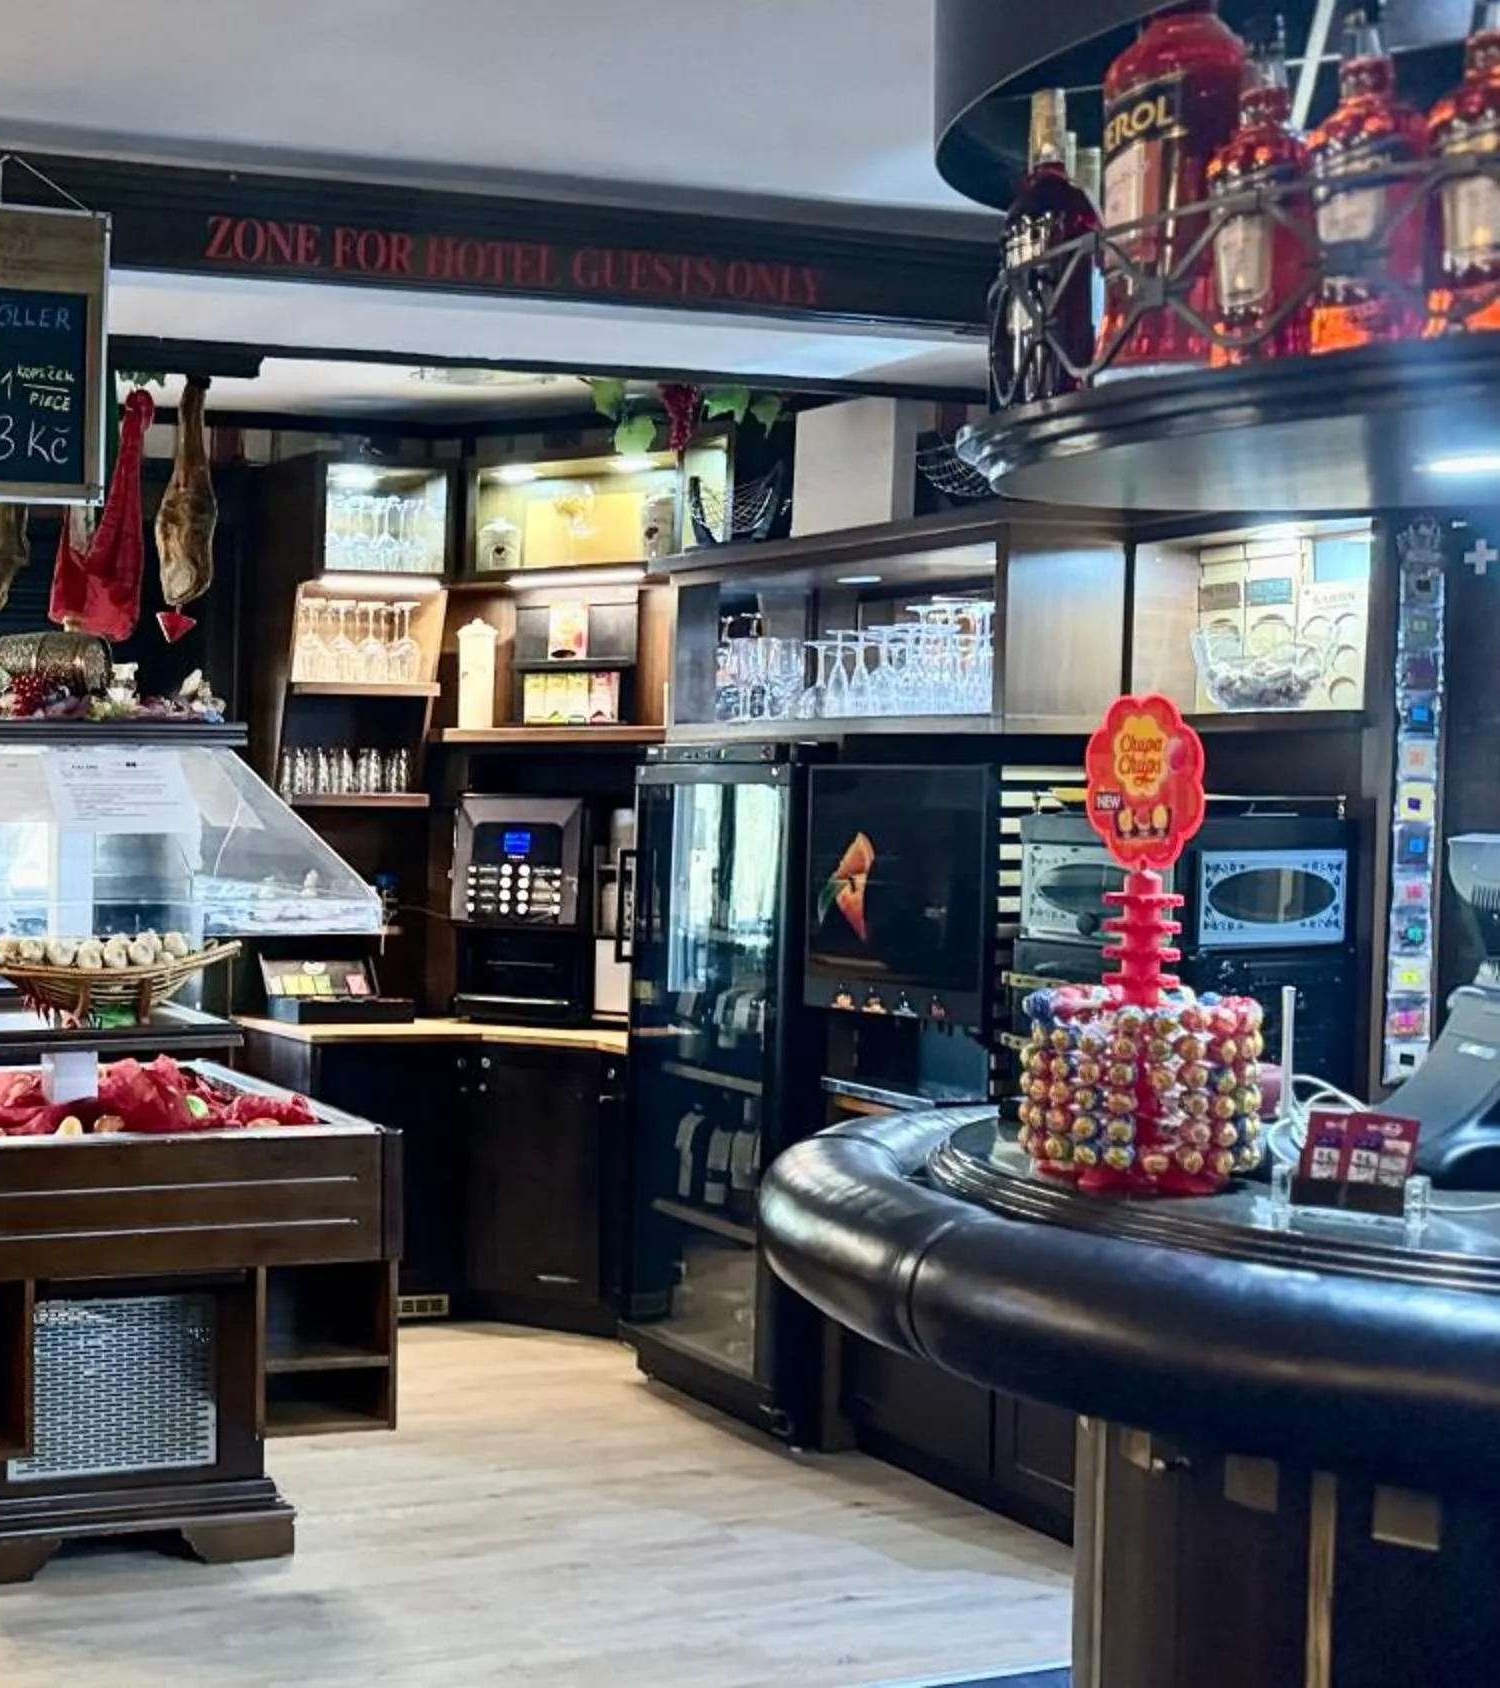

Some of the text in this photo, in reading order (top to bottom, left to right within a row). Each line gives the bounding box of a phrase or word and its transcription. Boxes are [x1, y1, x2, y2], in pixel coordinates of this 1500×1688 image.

[1104, 95, 1173, 153] EROL
[205, 215, 825, 305] ZONE FOR HOTEL GUESTS ONLY
[0, 369, 12, 400] 1
[29, 391, 71, 412] PIECE
[27, 420, 71, 464] Kč
[1119, 734, 1163, 754] Chupa
[1118, 753, 1162, 784] Chups
[1096, 793, 1121, 810] NEW
